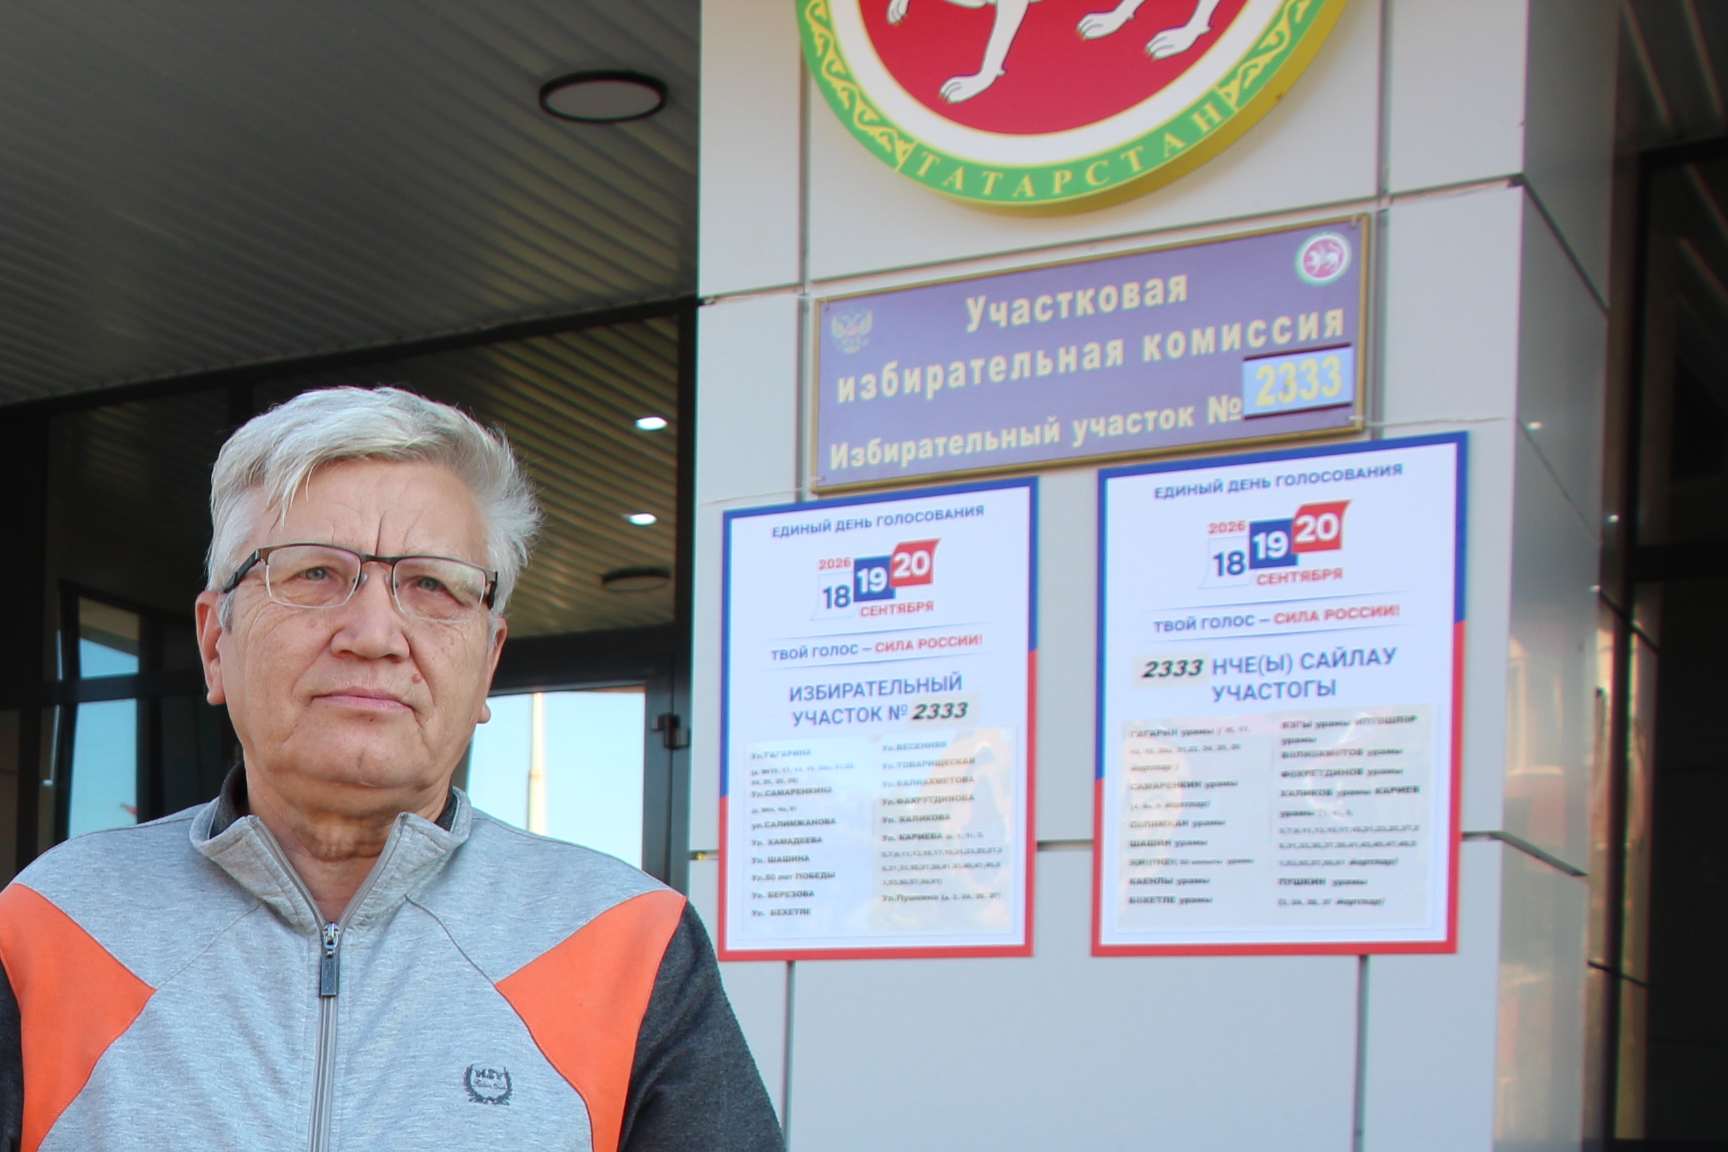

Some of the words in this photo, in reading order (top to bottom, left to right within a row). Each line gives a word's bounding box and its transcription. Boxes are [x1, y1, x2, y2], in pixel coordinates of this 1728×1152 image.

[915, 101, 1223, 198] ТАТАРСТАН
[966, 274, 1188, 333] Участковая
[837, 339, 1124, 403] избирательная
[1142, 308, 1344, 362] комиссия
[830, 415, 1061, 469] Избирательный
[1073, 405, 1195, 448] участок
[1207, 395, 1243, 423] №
[1255, 355, 1342, 407] 2333
[1154, 479, 1223, 499] ЕДИНЫЙ
[1227, 477, 1271, 493] ДЕНЬ
[1276, 463, 1403, 487] ГОЛОСОВАНИЯ
[772, 519, 832, 538] ЕДИНЫЙ
[835, 518, 873, 533] ДЕНЬ
[876, 505, 985, 527] ГОЛОСОВАНИЯ
[1213, 550, 1246, 577] 18
[1252, 530, 1289, 560] 19
[1294, 512, 1340, 543] 20
[822, 584, 851, 609] 18
[857, 566, 888, 595] 19
[893, 549, 932, 579] 20
[1256, 567, 1343, 586] СЕНТЯБРЯ
[860, 600, 934, 617] СЕНТЯБРЯ
[1154, 616, 1197, 633] ТВОЙ
[1201, 614, 1255, 630] ГОЛОС
[1274, 608, 1320, 625] СИЛА
[1324, 604, 1400, 621] РОССИИ!
[771, 645, 808, 661] ТВОЙ
[813, 643, 859, 659] ГОЛОС
[875, 638, 914, 653] СИЛА
[918, 634, 983, 650] РОССИИ!
[1141, 658, 1205, 679] 2333
[1212, 653, 1293, 677] НЧЕ(Ы)
[1300, 646, 1397, 671] САЙЛАУ
[789, 671, 963, 702] ИЗБИРАТЕЛЬНЫЙ
[1212, 679, 1337, 703] УЧАСТОГЫ
[792, 706, 883, 728] УЧАСТОК
[912, 701, 970, 721] 2333
[795, 871, 836, 881] ПОБЕДЫ
